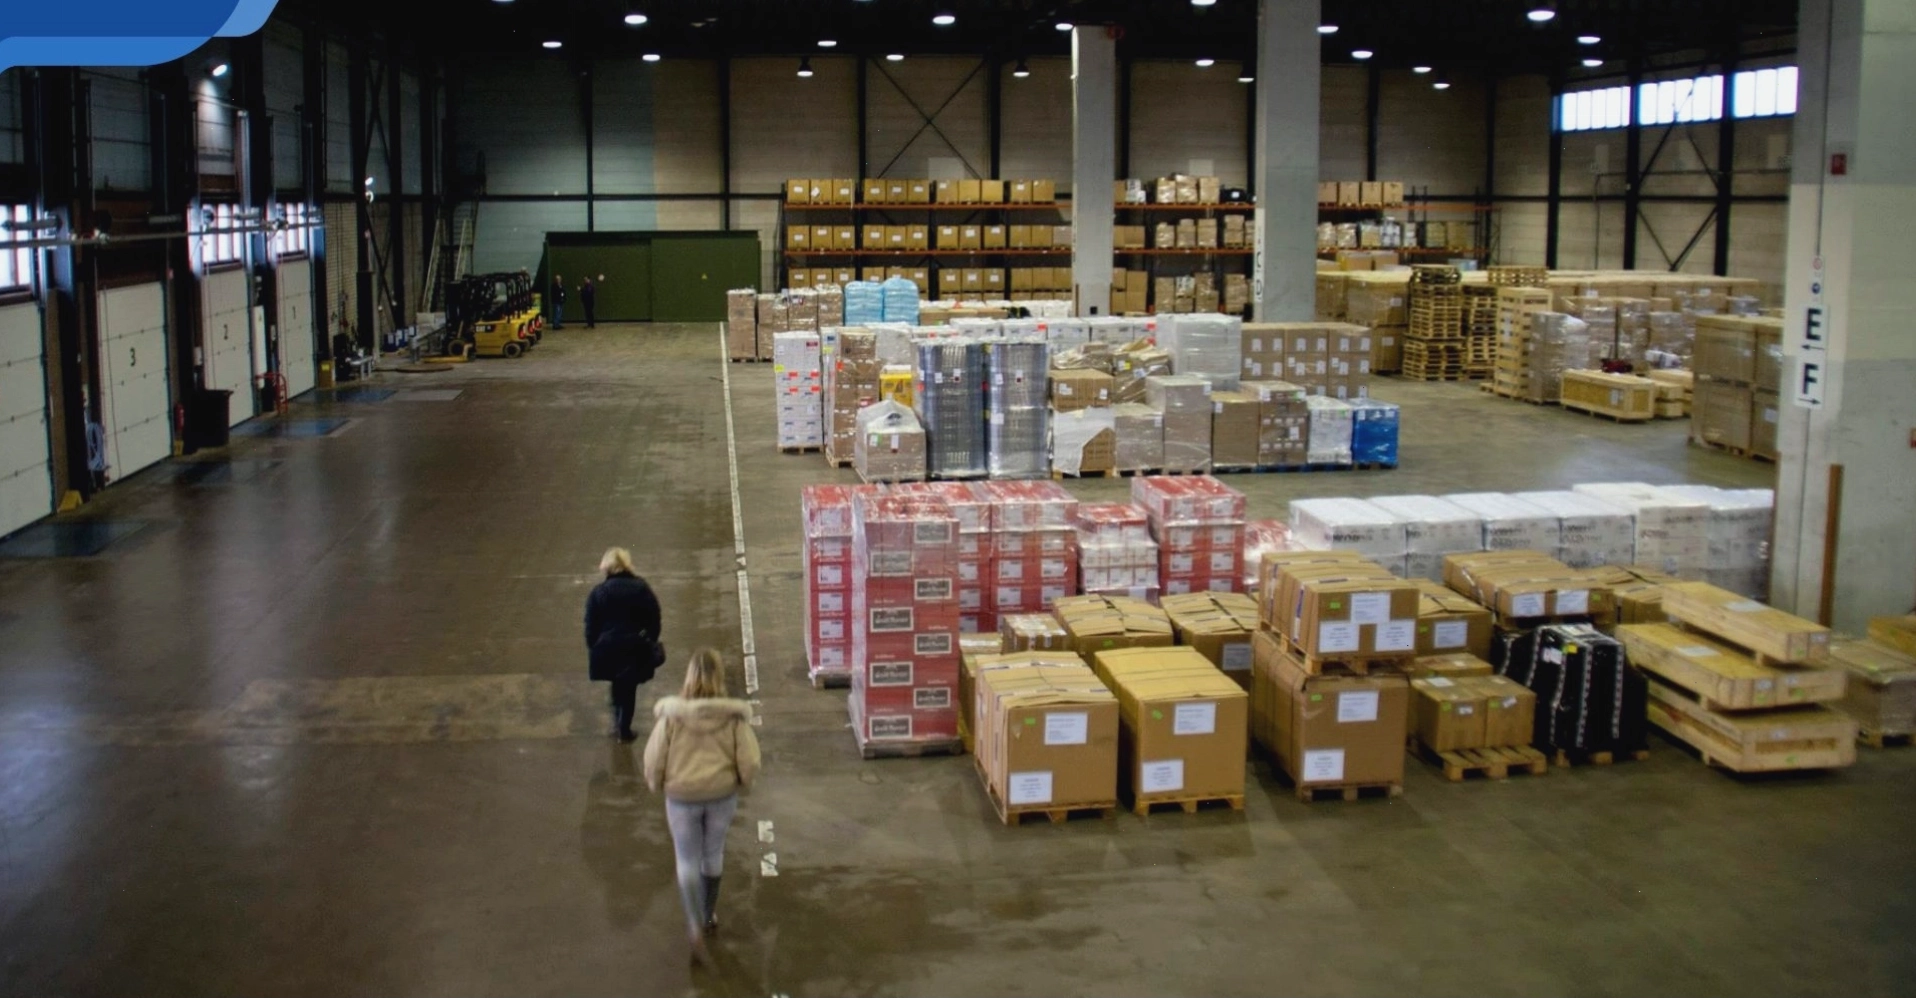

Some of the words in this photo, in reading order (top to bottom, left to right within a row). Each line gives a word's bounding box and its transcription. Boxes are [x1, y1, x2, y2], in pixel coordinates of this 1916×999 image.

[223, 323, 229, 341] 2
[1806, 307, 1822, 340] E
[129, 347, 136, 367] 3
[1803, 362, 1819, 395] F
